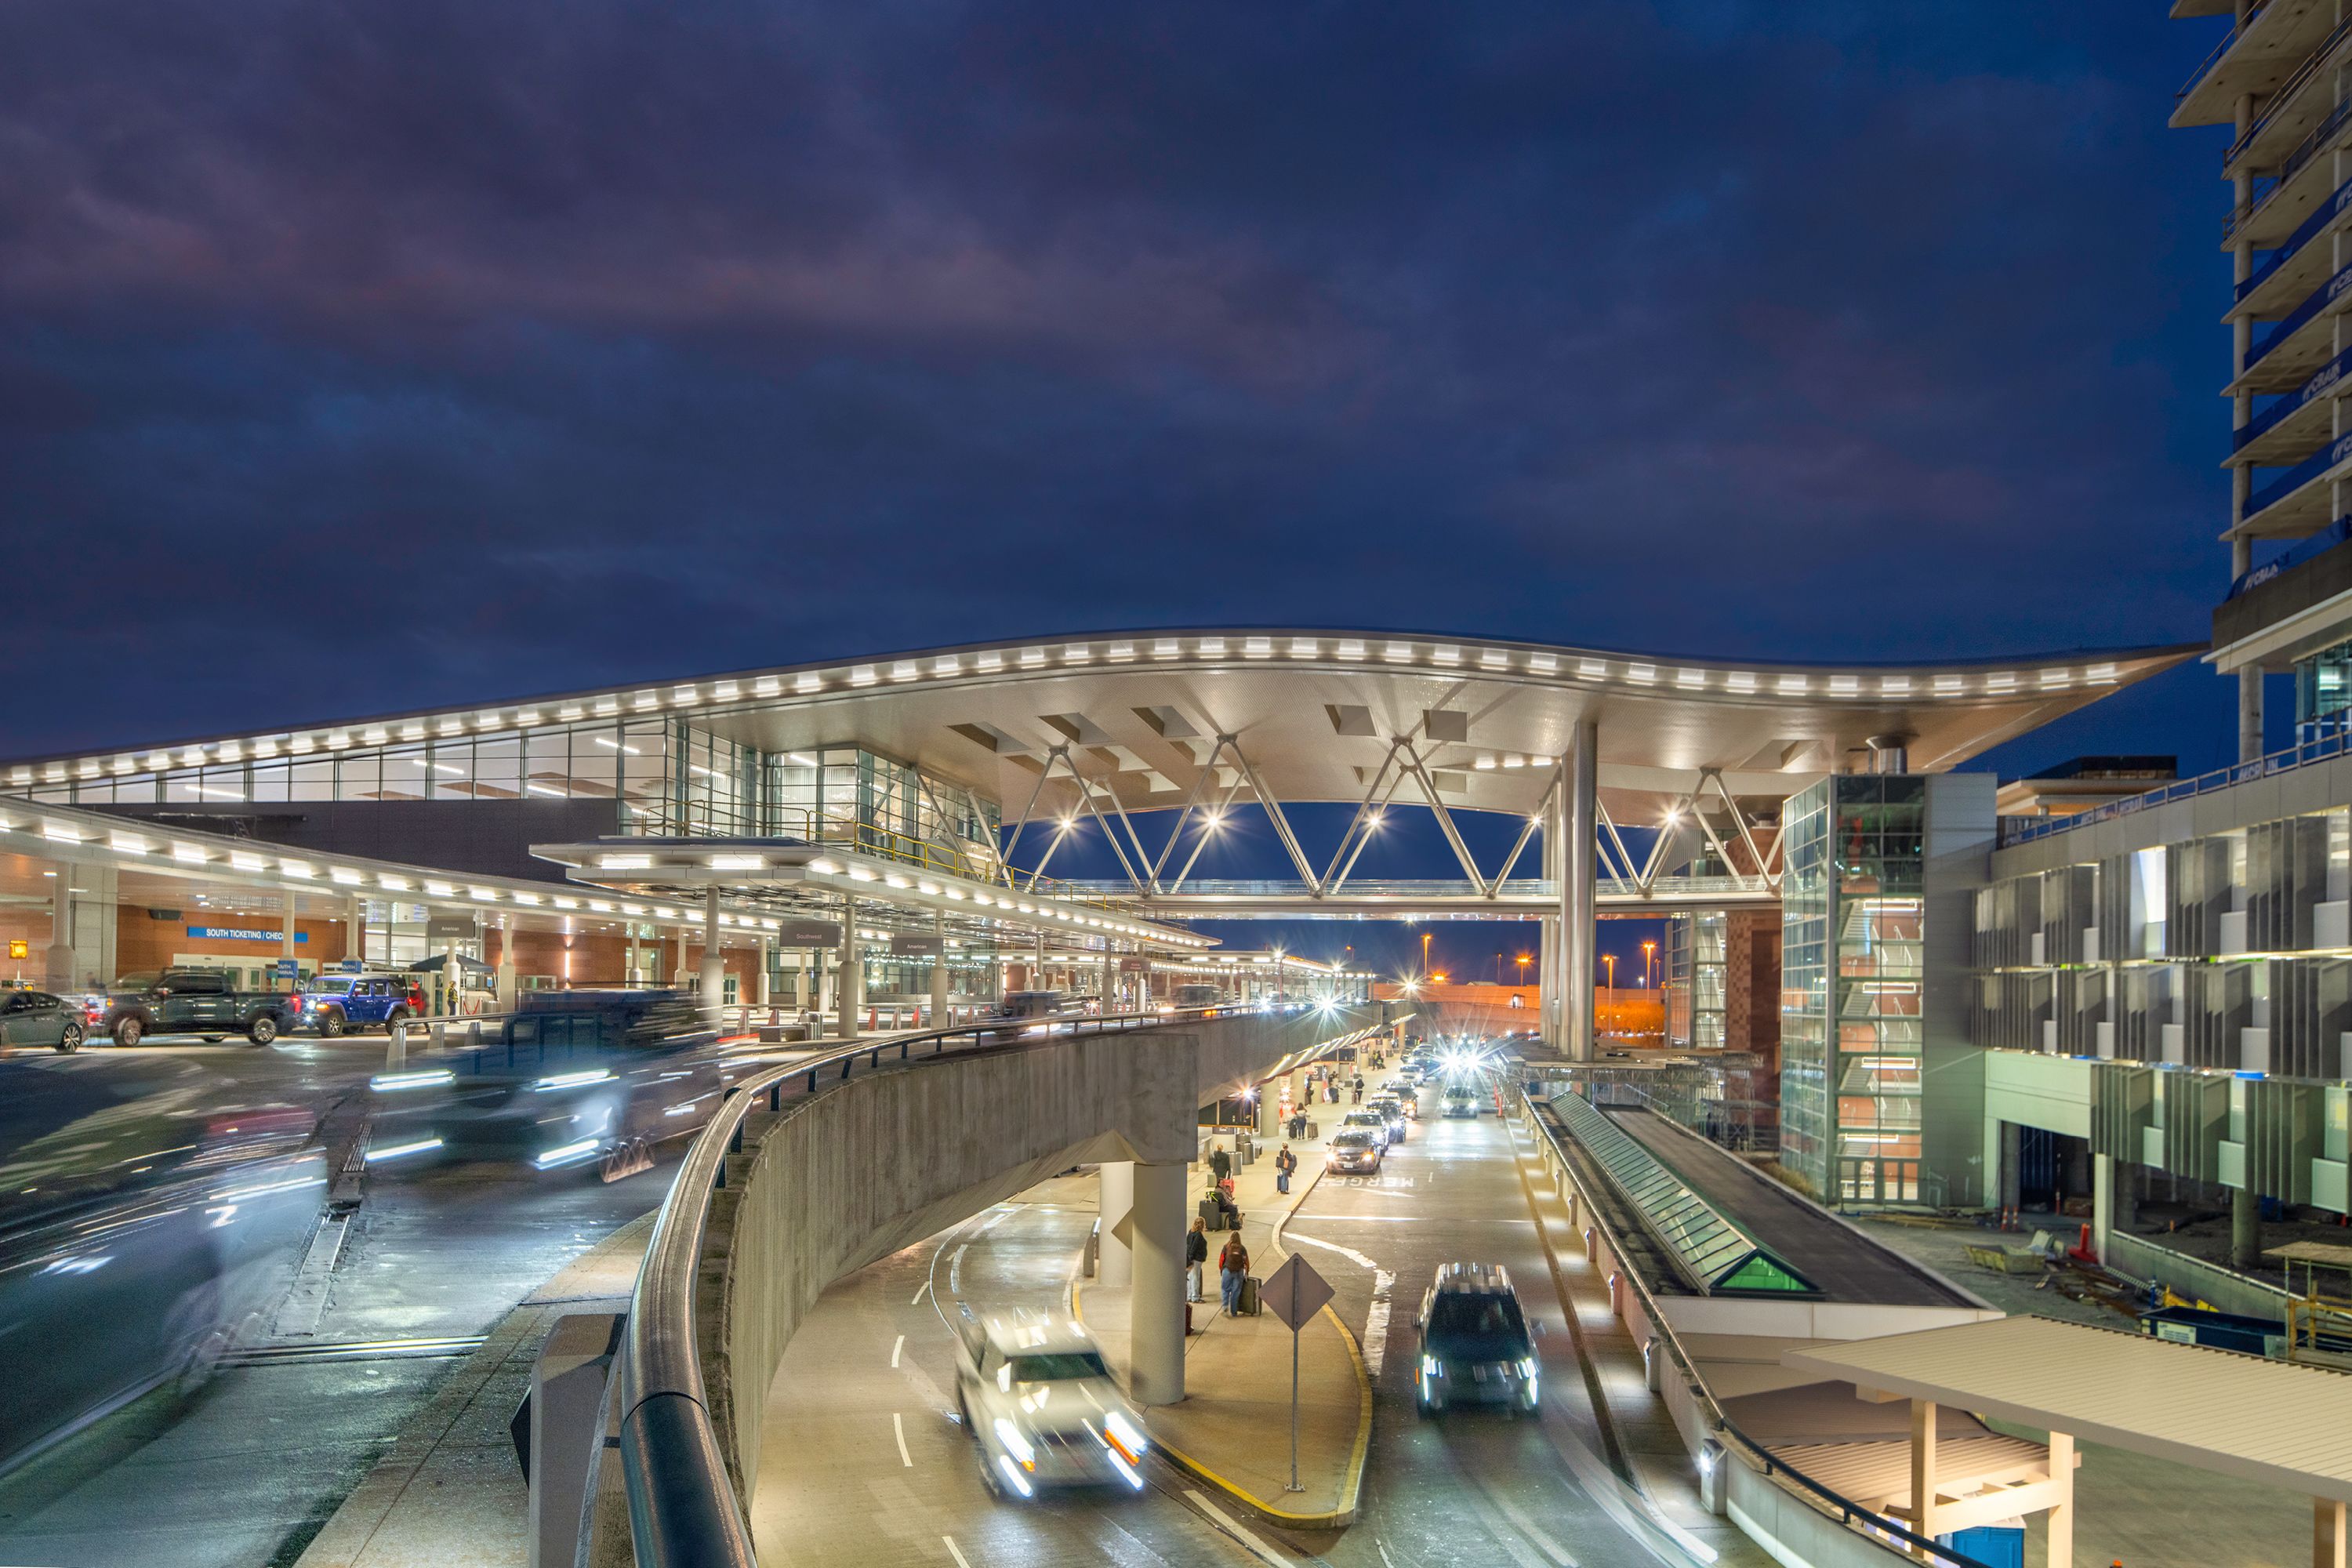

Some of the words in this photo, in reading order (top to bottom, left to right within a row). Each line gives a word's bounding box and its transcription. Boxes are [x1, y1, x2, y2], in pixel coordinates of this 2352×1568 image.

[206, 928, 228, 938] SOUTH
[229, 929, 262, 939] TICKETING
[265, 931, 284, 940] CHEC
